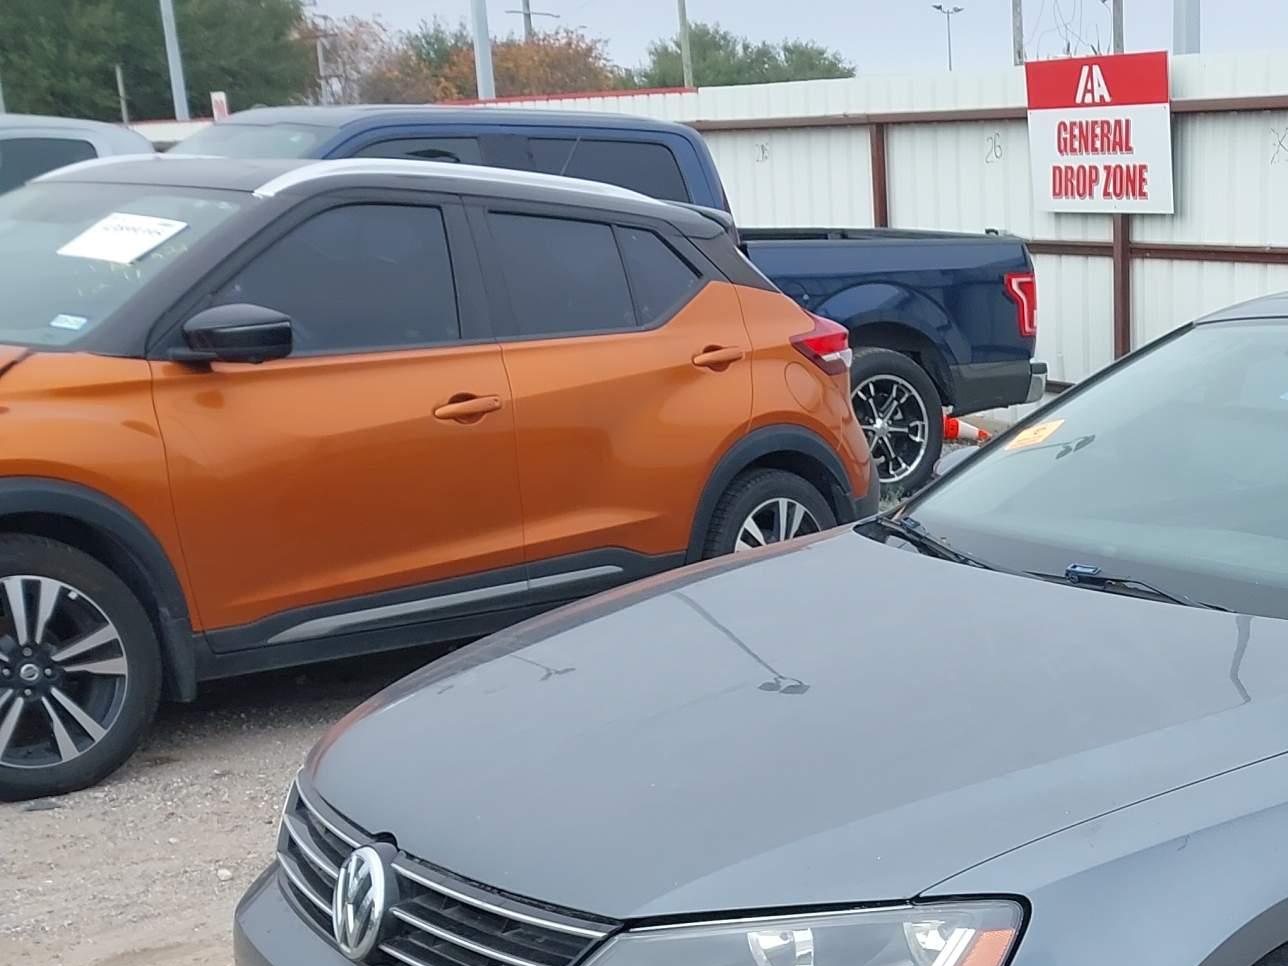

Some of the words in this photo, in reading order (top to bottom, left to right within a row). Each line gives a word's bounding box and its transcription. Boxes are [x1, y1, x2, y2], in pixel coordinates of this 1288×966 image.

[1056, 118, 1134, 156] GENERAL
[1052, 164, 1100, 200] DROP
[1102, 164, 1148, 200] ZONE
